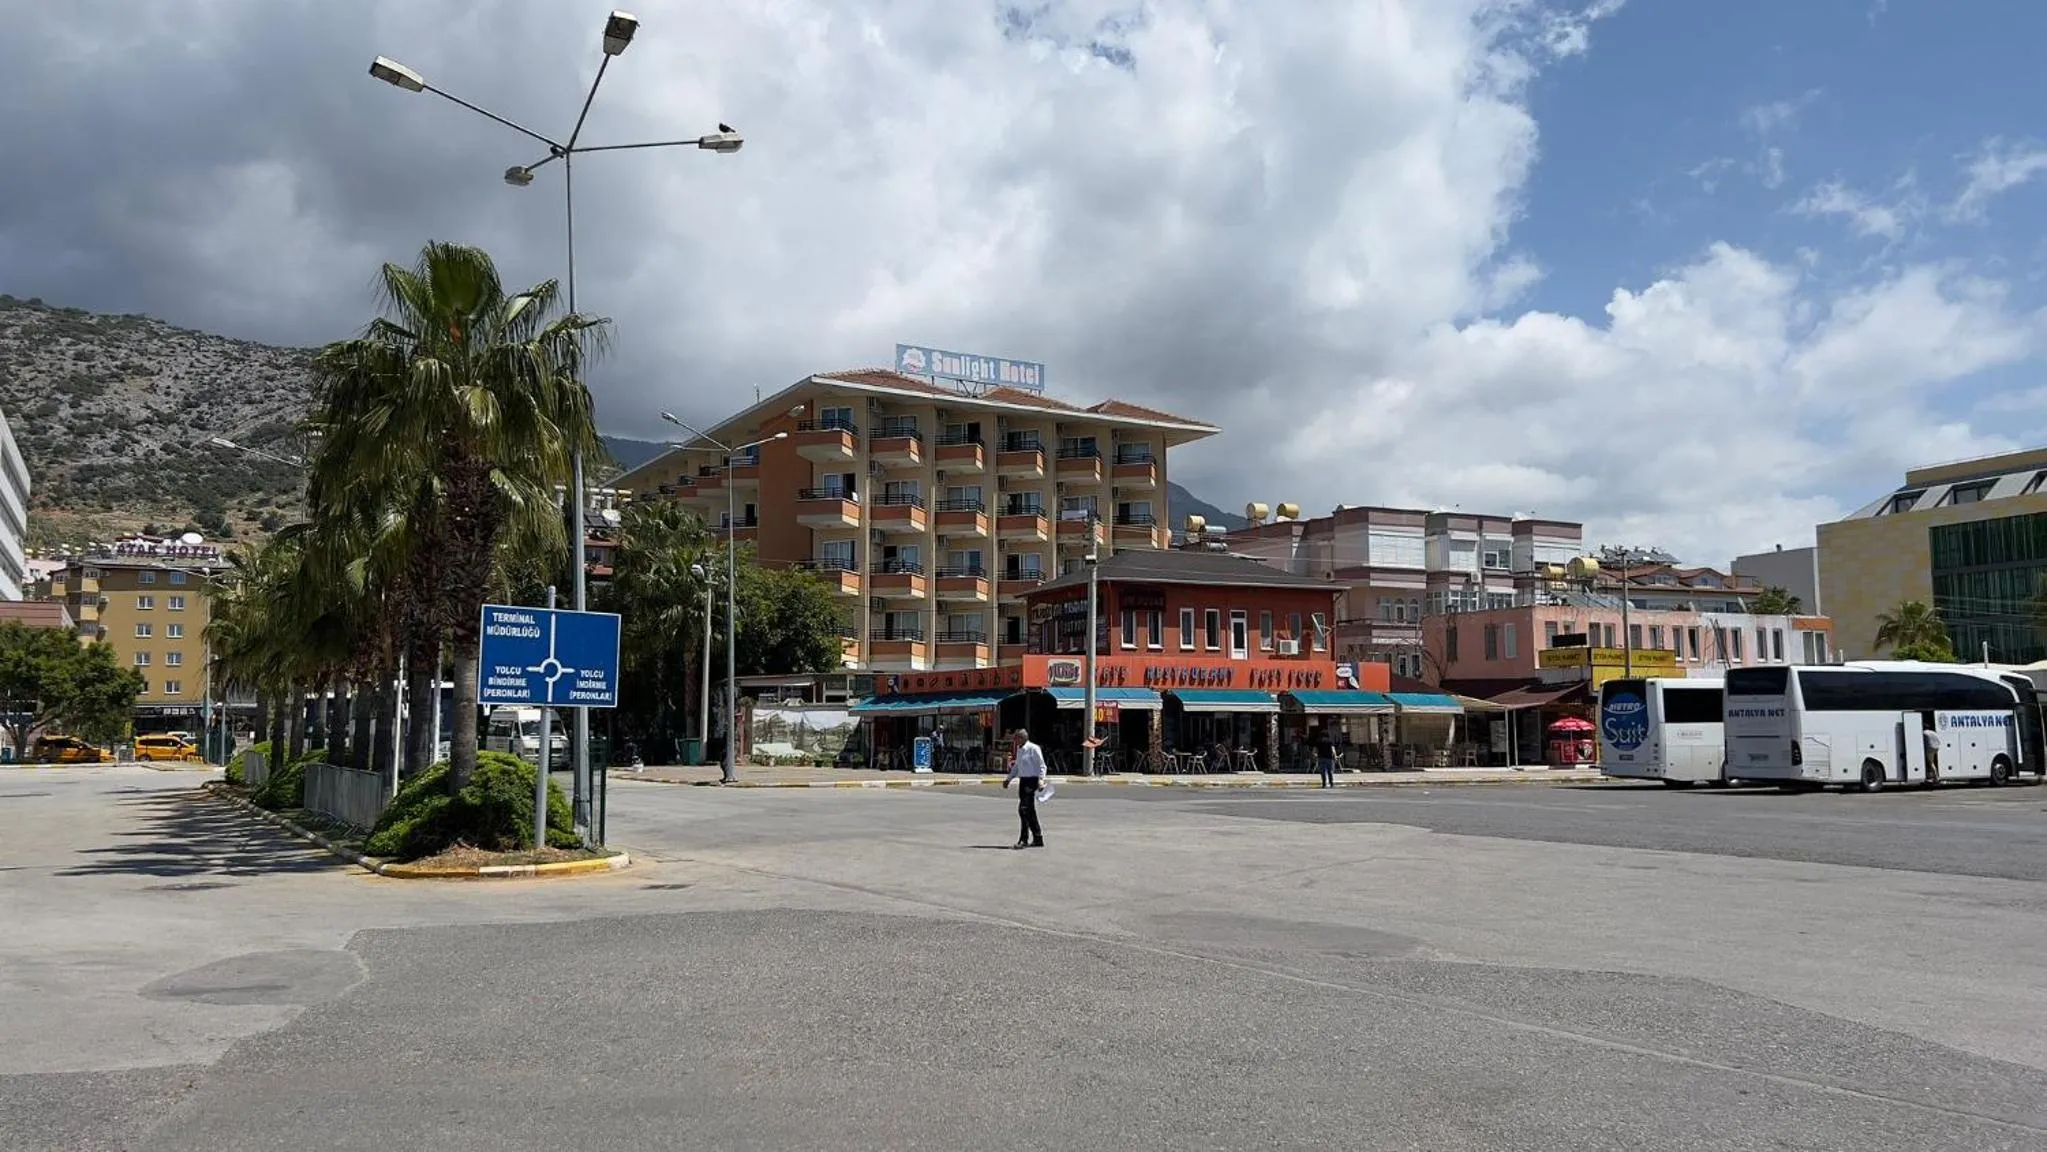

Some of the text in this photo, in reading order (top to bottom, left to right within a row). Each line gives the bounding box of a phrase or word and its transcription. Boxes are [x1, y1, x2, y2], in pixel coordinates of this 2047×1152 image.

[931, 350, 1041, 386] Sunlight Hotel
[492, 612, 536, 625] TERMİNAL
[486, 625, 541, 638] MÜDÜRLÜĞÜ
[494, 666, 522, 676] YOLCU
[580, 669, 604, 678] YOLCU
[488, 675, 527, 686] BİNDİRME
[576, 679, 607, 689] İNDİRME
[483, 687, 531, 699] (PERONLAR)
[569, 690, 613, 701] (PERONLAR)
[1608, 702, 1640, 712] METRO
[1728, 708, 1765, 718] ANTALYA
